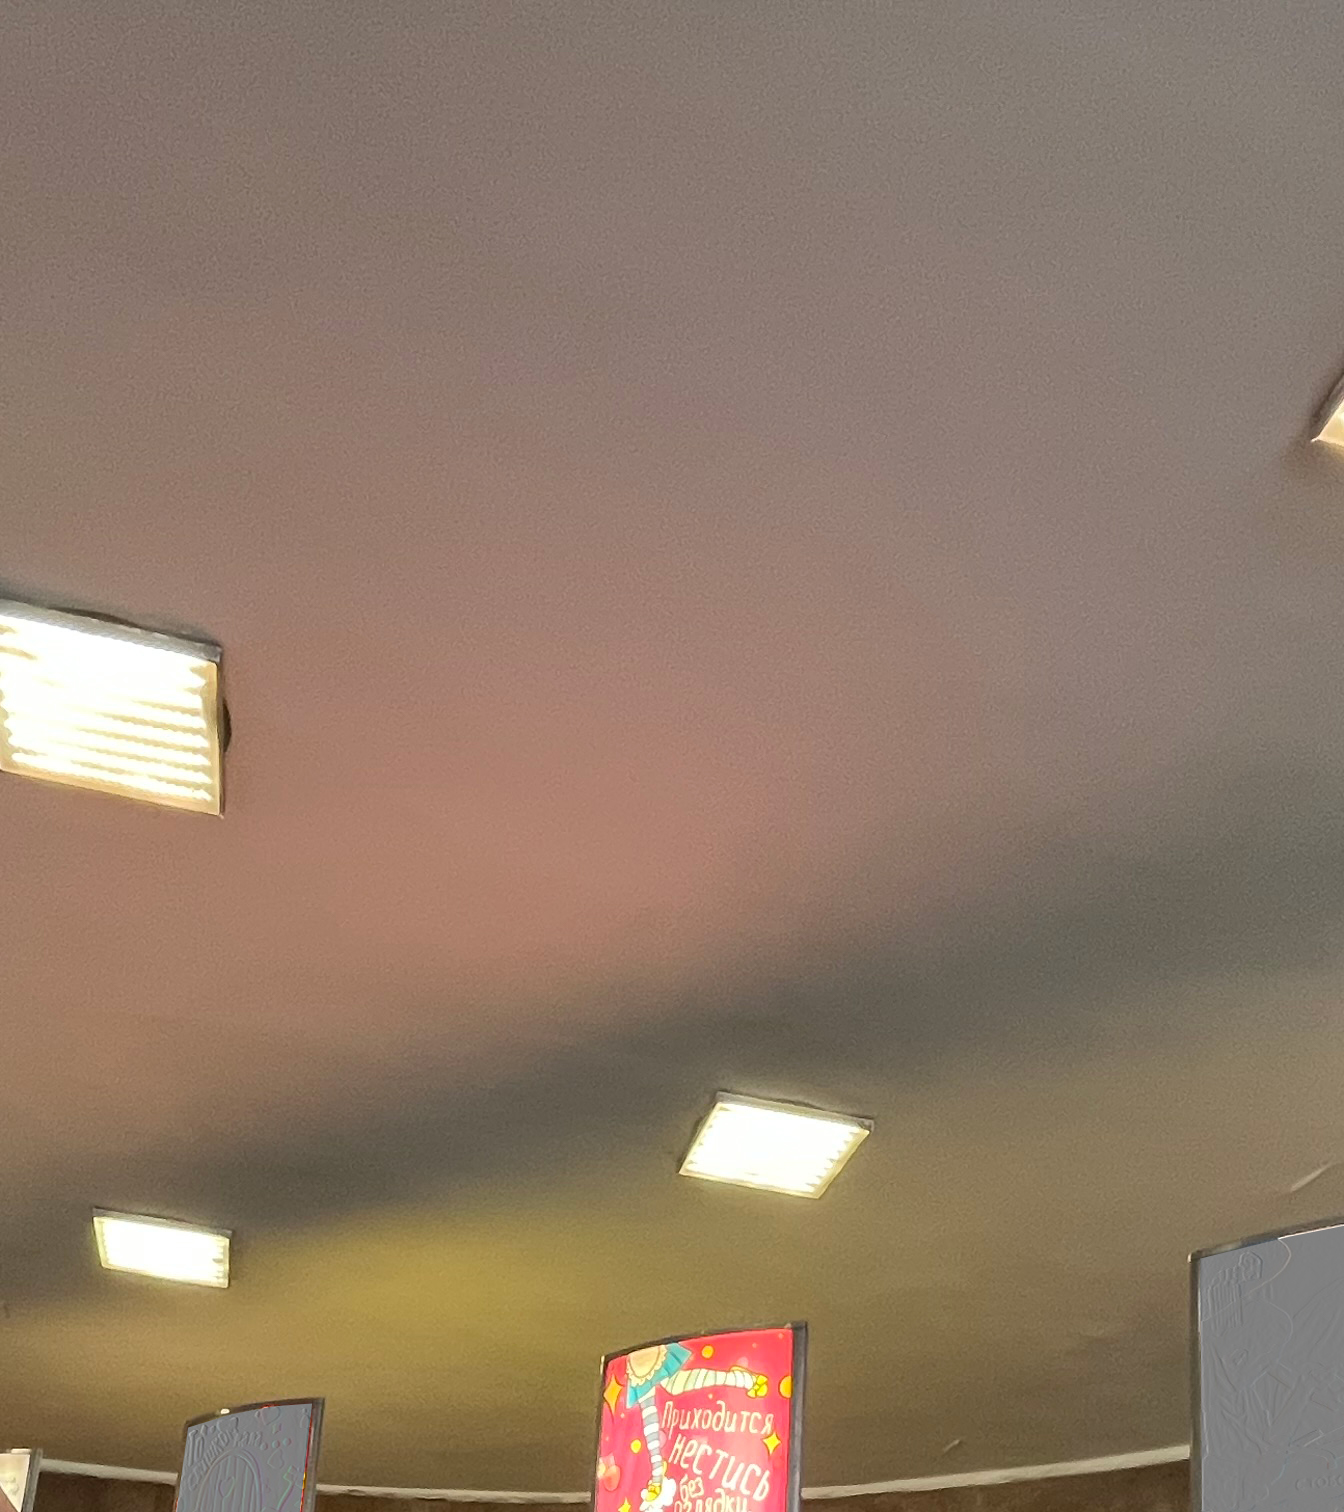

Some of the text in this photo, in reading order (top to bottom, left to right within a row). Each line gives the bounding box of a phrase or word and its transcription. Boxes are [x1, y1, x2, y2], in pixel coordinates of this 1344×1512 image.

[662, 1400, 774, 1439] Приходится
[668, 1434, 771, 1501] нестись
[679, 1474, 704, 1503] без
